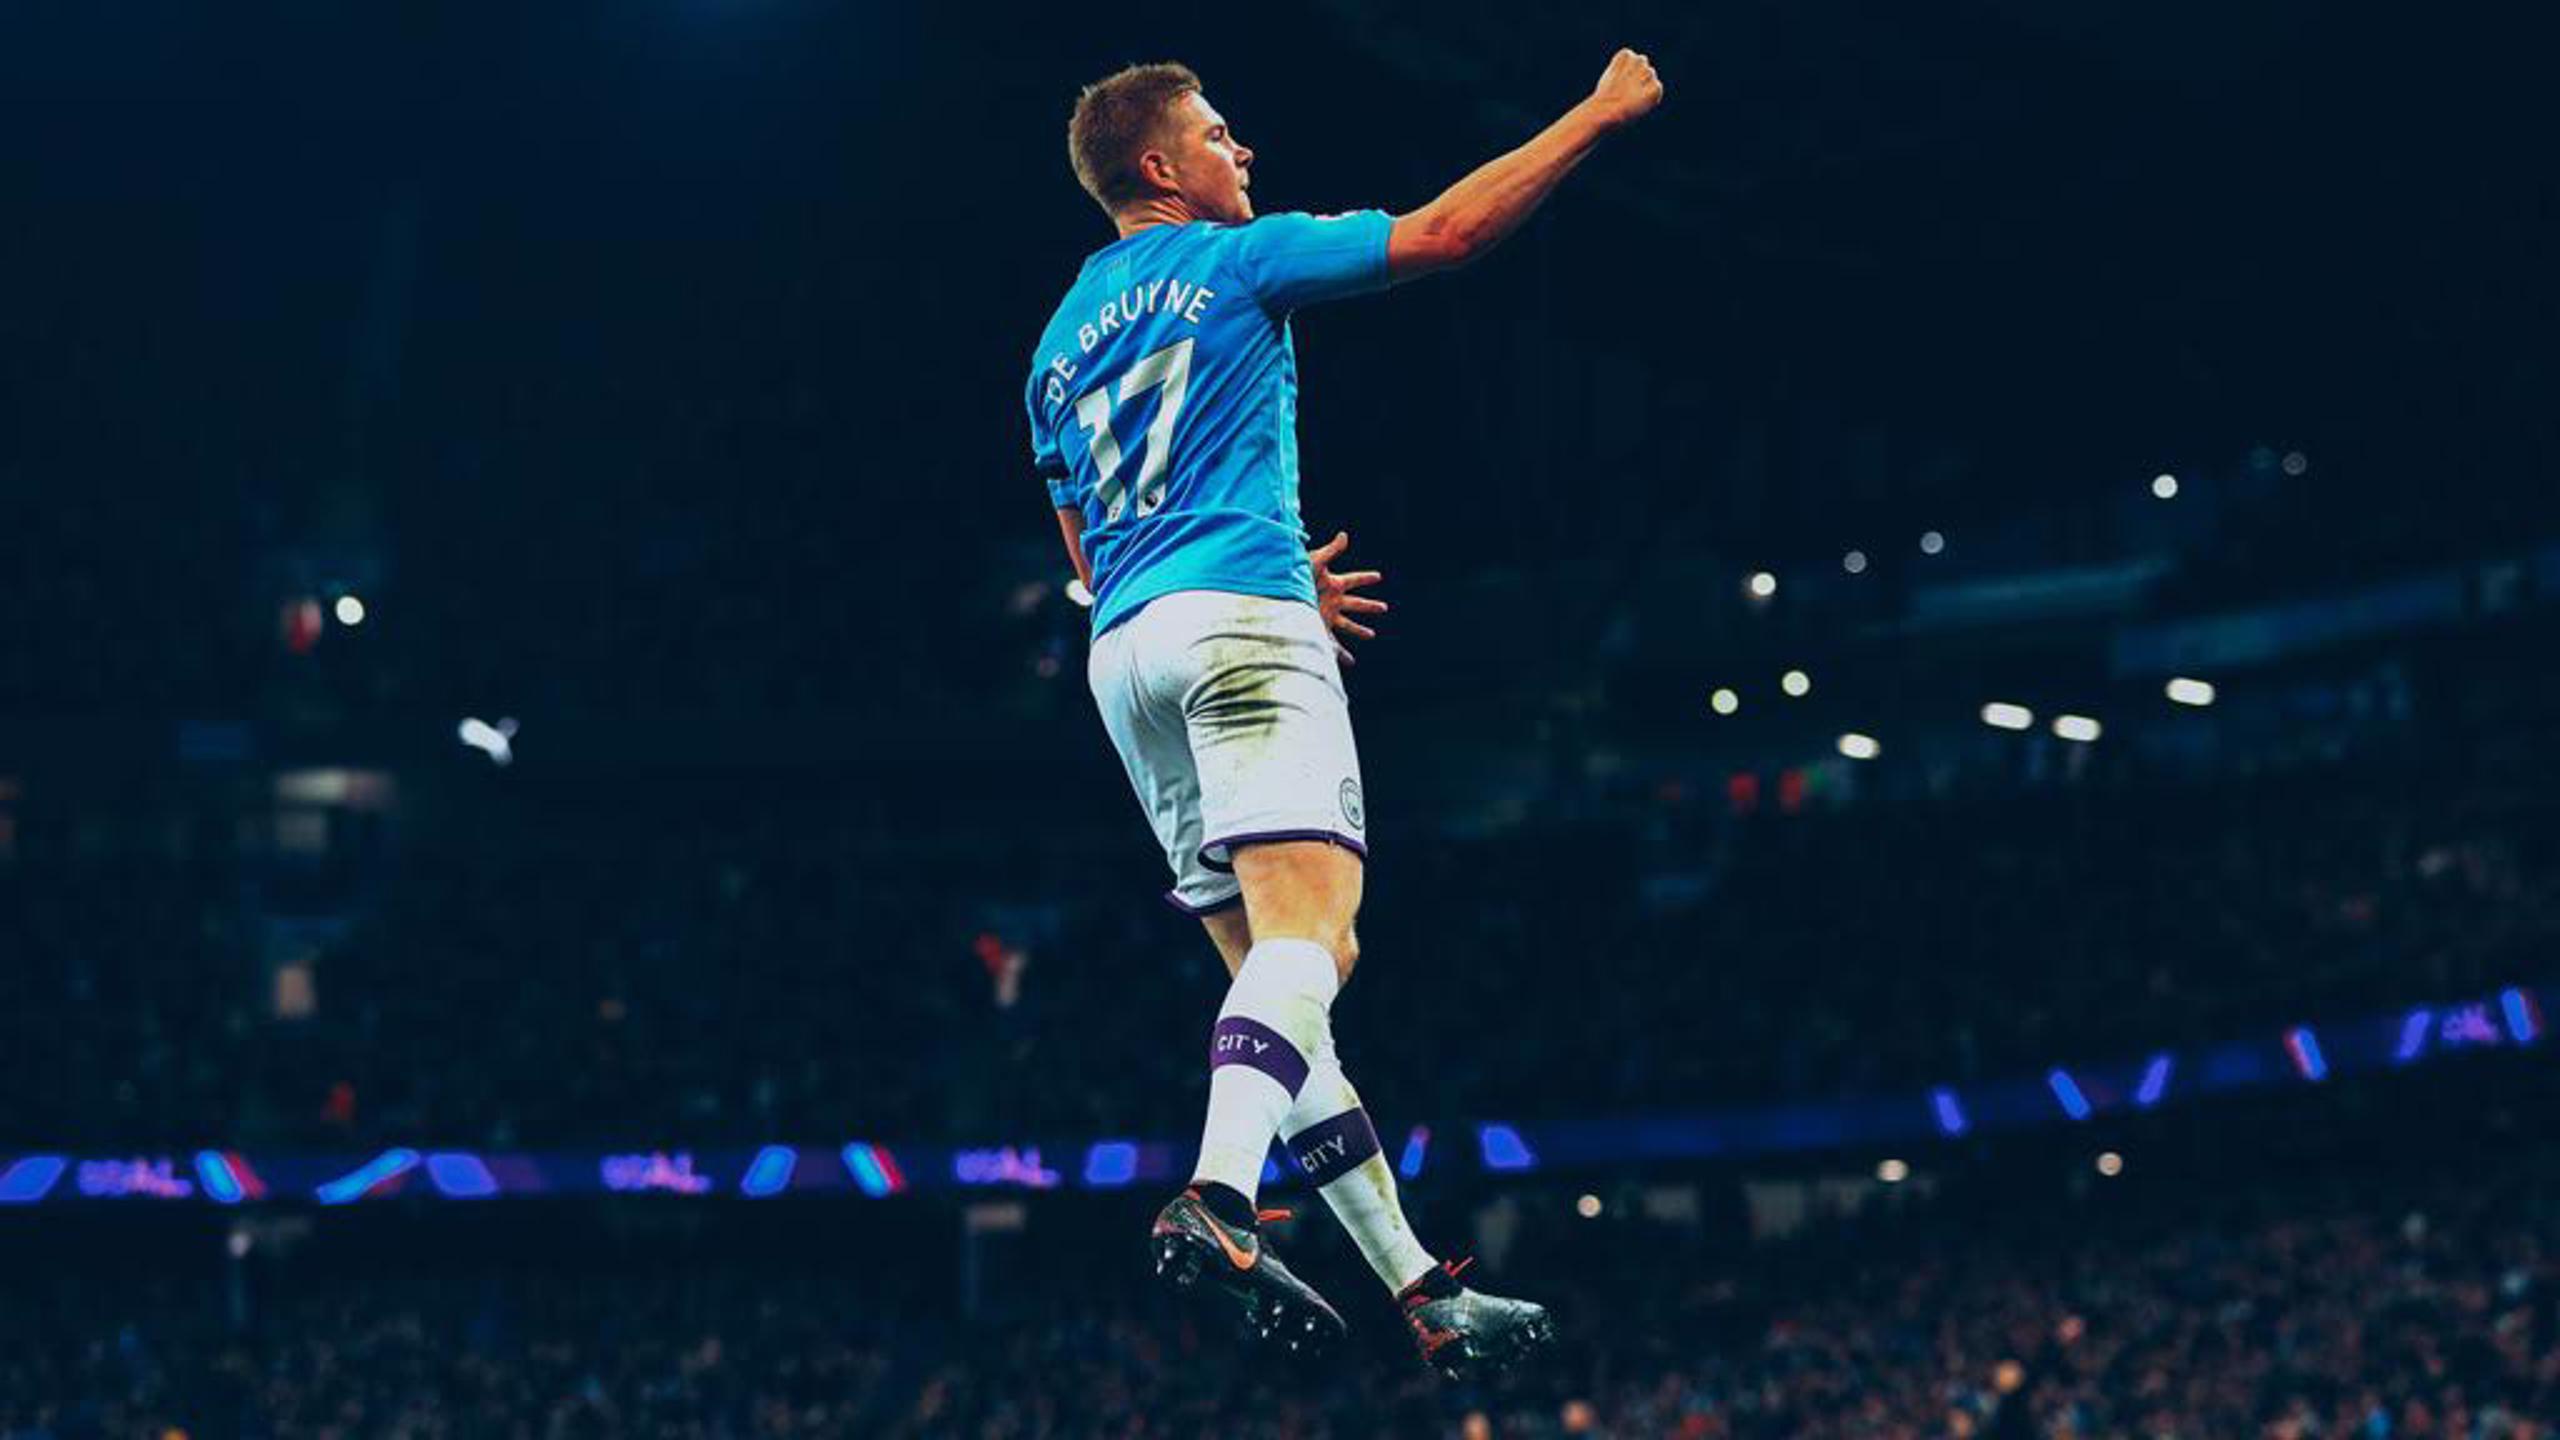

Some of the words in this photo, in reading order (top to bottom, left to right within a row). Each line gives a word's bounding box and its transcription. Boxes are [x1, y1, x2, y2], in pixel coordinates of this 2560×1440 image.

[1079, 280, 1214, 353] BRUYNE
[1075, 337, 1194, 523] 17
[1217, 1034, 1269, 1054] CITY
[1301, 1134, 1345, 1173] CITY
